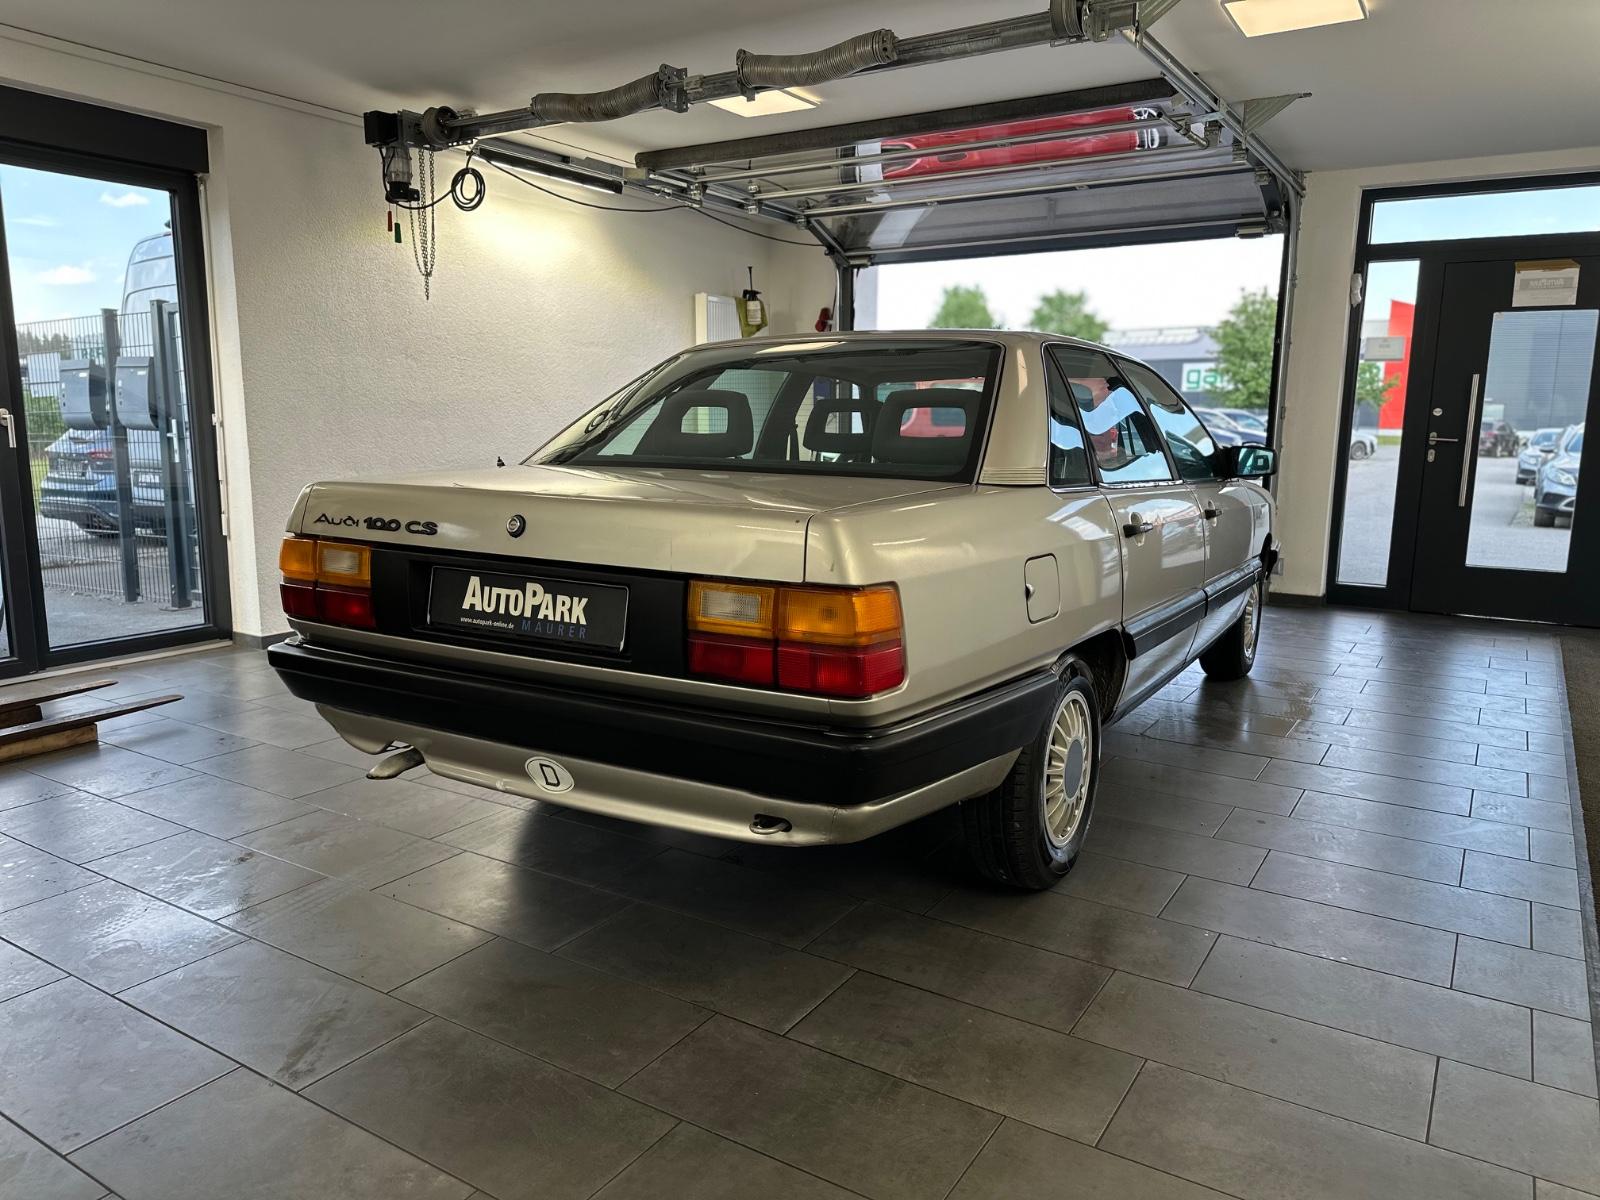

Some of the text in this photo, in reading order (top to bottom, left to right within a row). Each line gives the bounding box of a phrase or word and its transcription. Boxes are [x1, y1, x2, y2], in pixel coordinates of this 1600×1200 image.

[363, 516, 401, 532] 100
[404, 520, 438, 536] CS
[460, 616, 515, 630] www.autopark-online.de
[521, 619, 587, 639] MAURER
[539, 763, 560, 787] D
